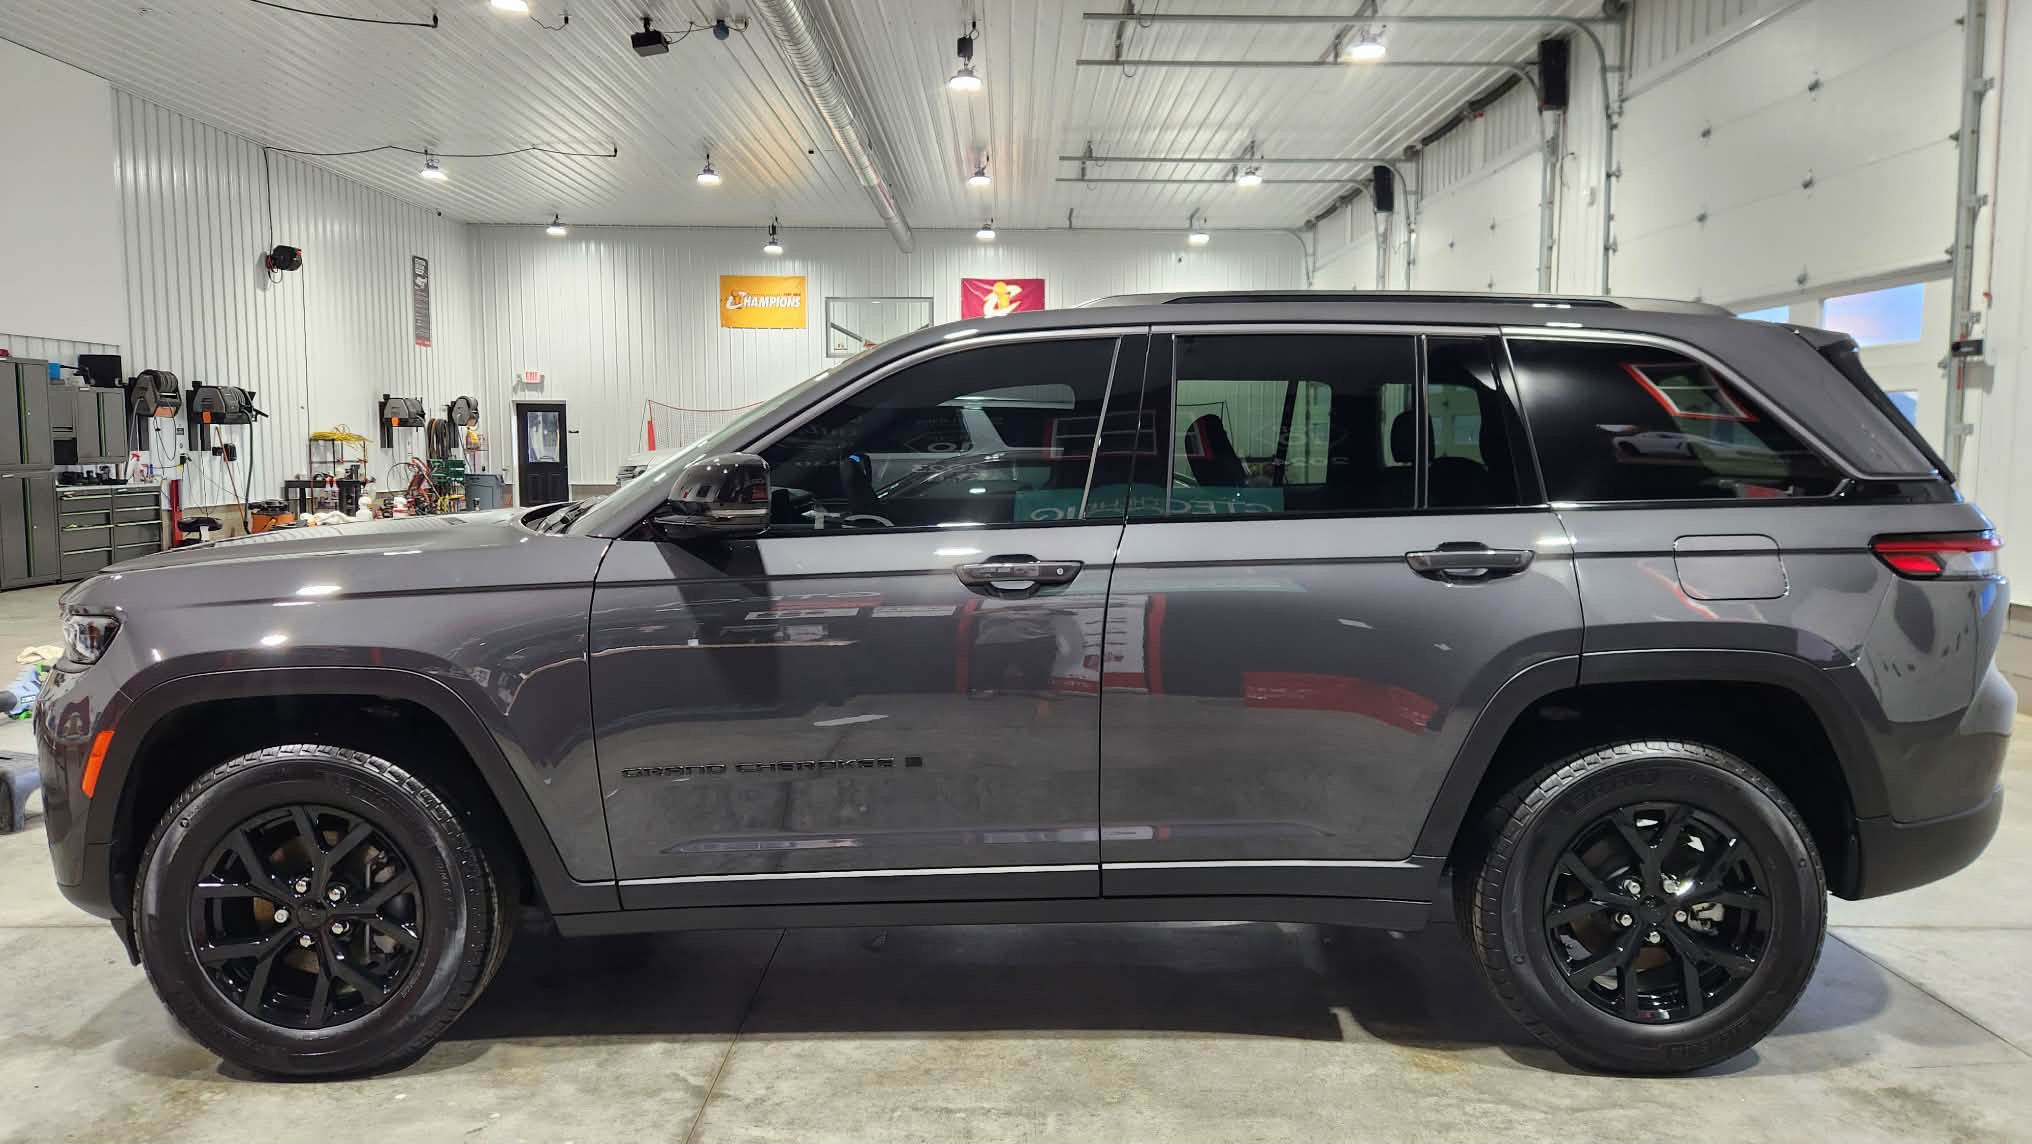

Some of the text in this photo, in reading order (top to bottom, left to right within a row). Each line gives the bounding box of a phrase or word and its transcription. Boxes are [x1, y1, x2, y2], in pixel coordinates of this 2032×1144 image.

[726, 289, 801, 310] CHAMPIONS
[525, 371, 539, 381] EXIT
[622, 757, 895, 777] GRAND CHEROKEE
